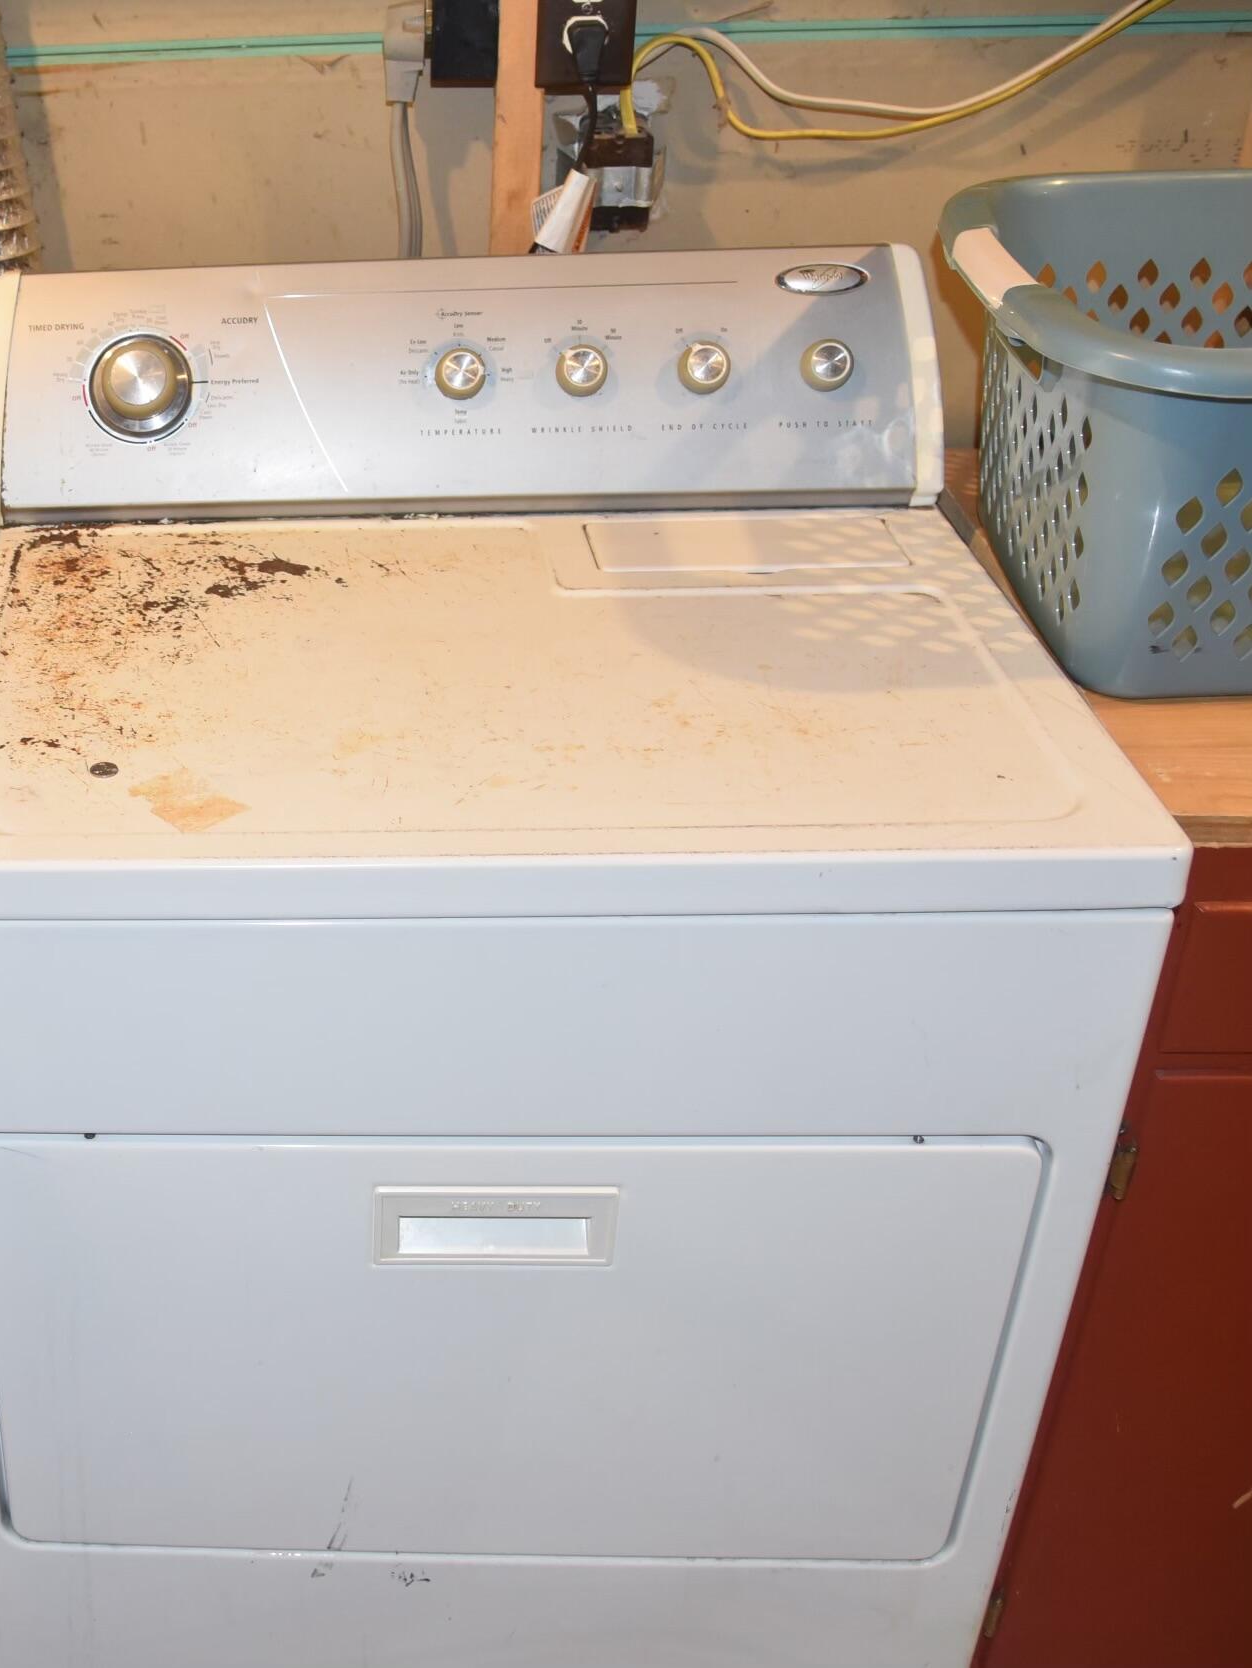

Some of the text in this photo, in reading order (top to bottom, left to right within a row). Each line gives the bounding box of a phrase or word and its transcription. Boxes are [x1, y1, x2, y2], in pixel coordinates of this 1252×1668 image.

[221, 316, 259, 326] ACCUDRY
[28, 324, 53, 332] TIMED
[54, 322, 85, 332] DRYING
[232, 377, 259, 385] Preferred
[661, 421, 749, 431] END OF CYCLE
[779, 418, 873, 428] PUSH TO START
[531, 424, 633, 435] WRINKLE SHIELD
